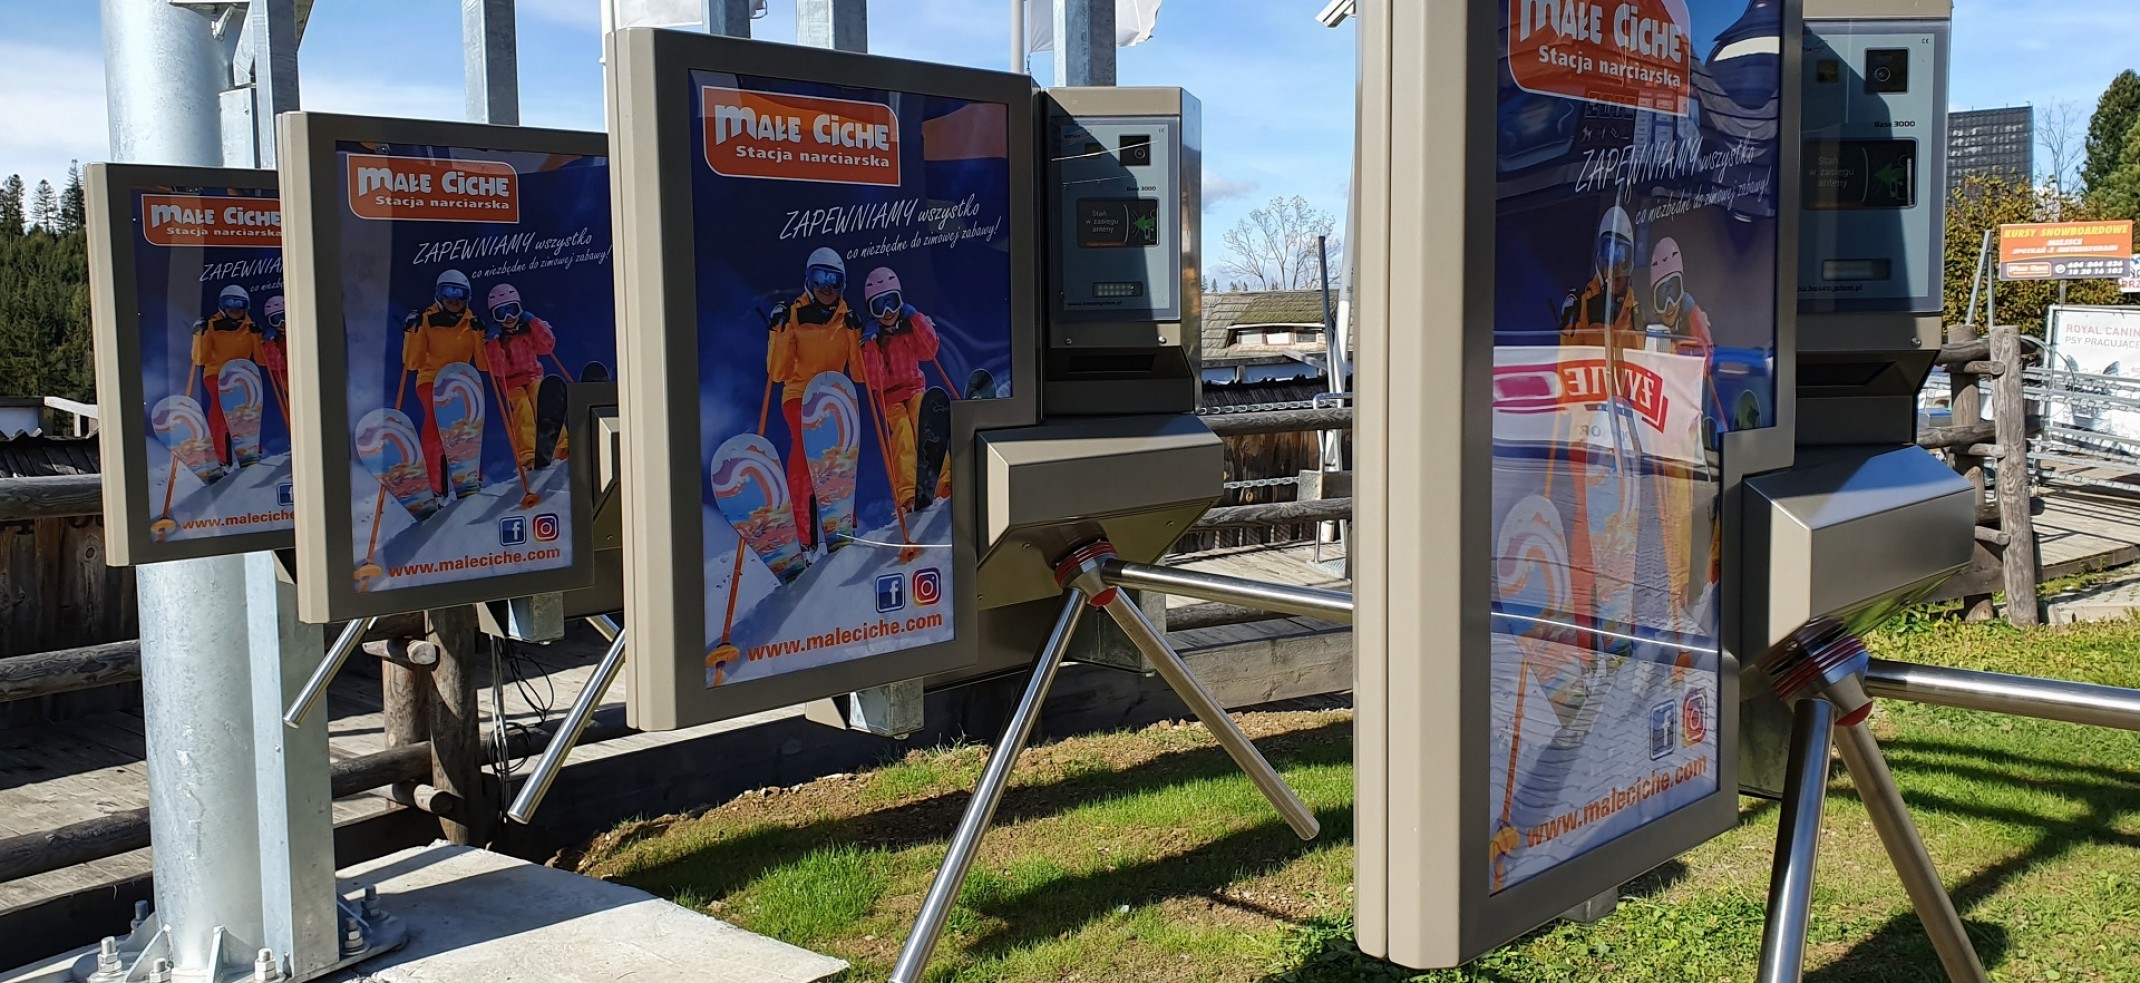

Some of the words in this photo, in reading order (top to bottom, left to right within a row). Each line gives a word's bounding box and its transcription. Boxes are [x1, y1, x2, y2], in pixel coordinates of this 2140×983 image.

[1538, 45, 1592, 74] Stacja
[1600, 60, 1681, 88] narciarska
[1894, 120, 1915, 128] 3000
[736, 146, 792, 164] Stacja
[800, 152, 890, 168] narciarska
[1575, 136, 1703, 193] ZAPEWNIAMY
[1701, 132, 1754, 183] wszystko
[376, 196, 424, 208] Stacja
[430, 198, 510, 210] narciarska
[780, 198, 919, 240] ZAPEWNIAMY
[918, 193, 980, 230] wszystko
[1636, 209, 1646, 224] co
[167, 226, 208, 236] Stacja
[214, 228, 282, 236] narciarska
[846, 249, 858, 260] co
[861, 234, 908, 256] niezbędne
[910, 231, 922, 248] do
[924, 226, 961, 248] zimowej
[962, 216, 1002, 242] zabawy!
[2004, 228, 2036, 238] KURSY
[2041, 224, 2128, 236] SNOWBOARDOWE
[413, 232, 536, 264] ZAPEWNIAMY
[536, 227, 592, 255] wszystko
[200, 257, 283, 282] ZAPEWNIA
[472, 270, 482, 278] co
[529, 256, 539, 270] do
[540, 253, 573, 270] zimowej
[2065, 336, 2082, 344] PSY
[2066, 324, 2102, 334] ROYAL
[2105, 326, 2140, 336] CANIN
[388, 547, 560, 578] www.maleciche.com
[747, 613, 942, 662] www.maleciche.com
[1527, 756, 1707, 848] www.maleciche.com
